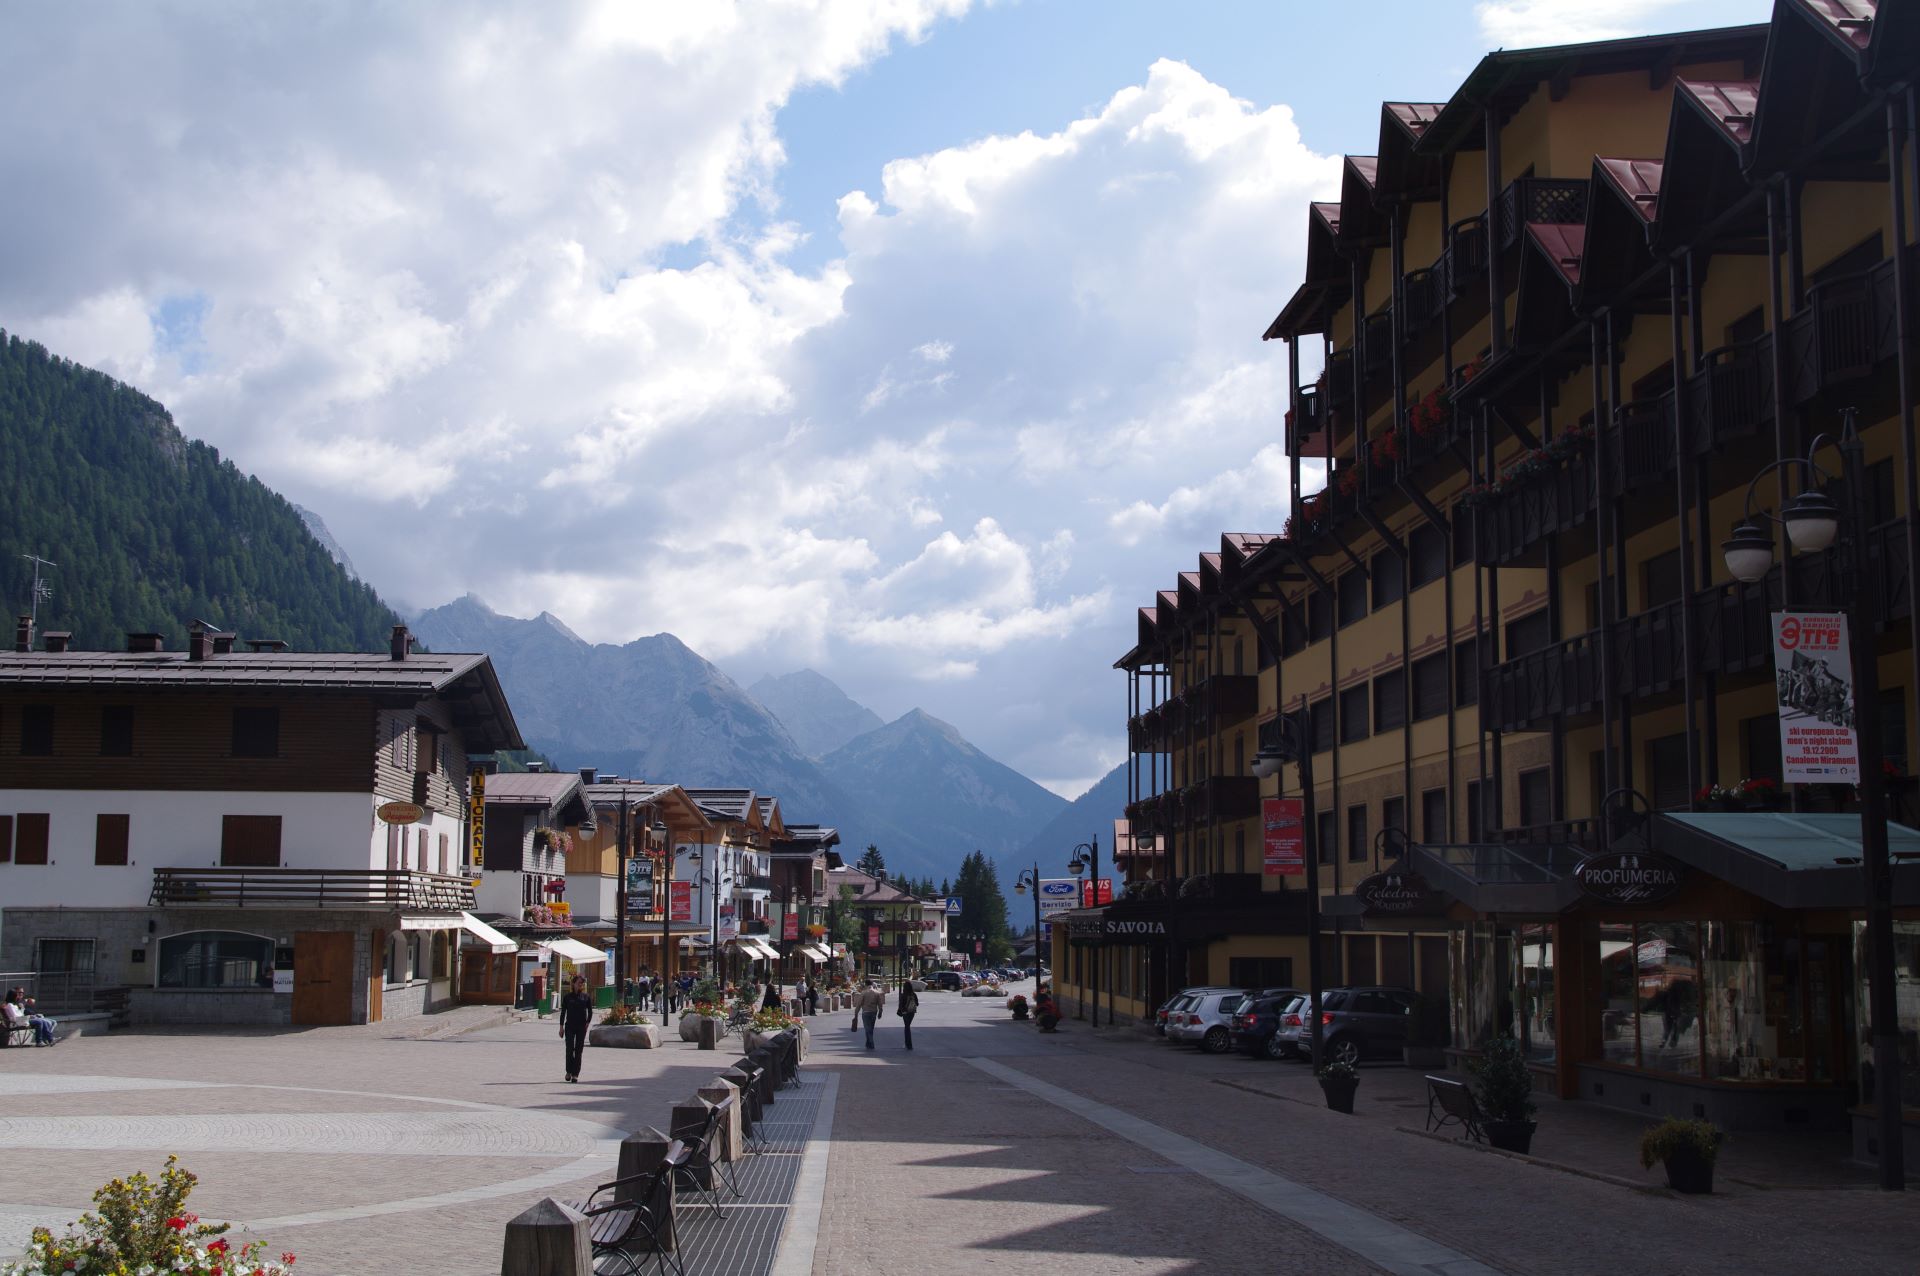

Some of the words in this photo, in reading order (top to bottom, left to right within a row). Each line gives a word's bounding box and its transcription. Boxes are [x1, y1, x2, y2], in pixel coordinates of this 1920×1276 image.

[1809, 737, 1828, 746] night
[473, 767, 484, 867] RISTORANTE
[1585, 869, 1677, 884] PROFUMERIA
[1048, 884, 1069, 893] Ford
[1106, 920, 1166, 934] SAVOIA
